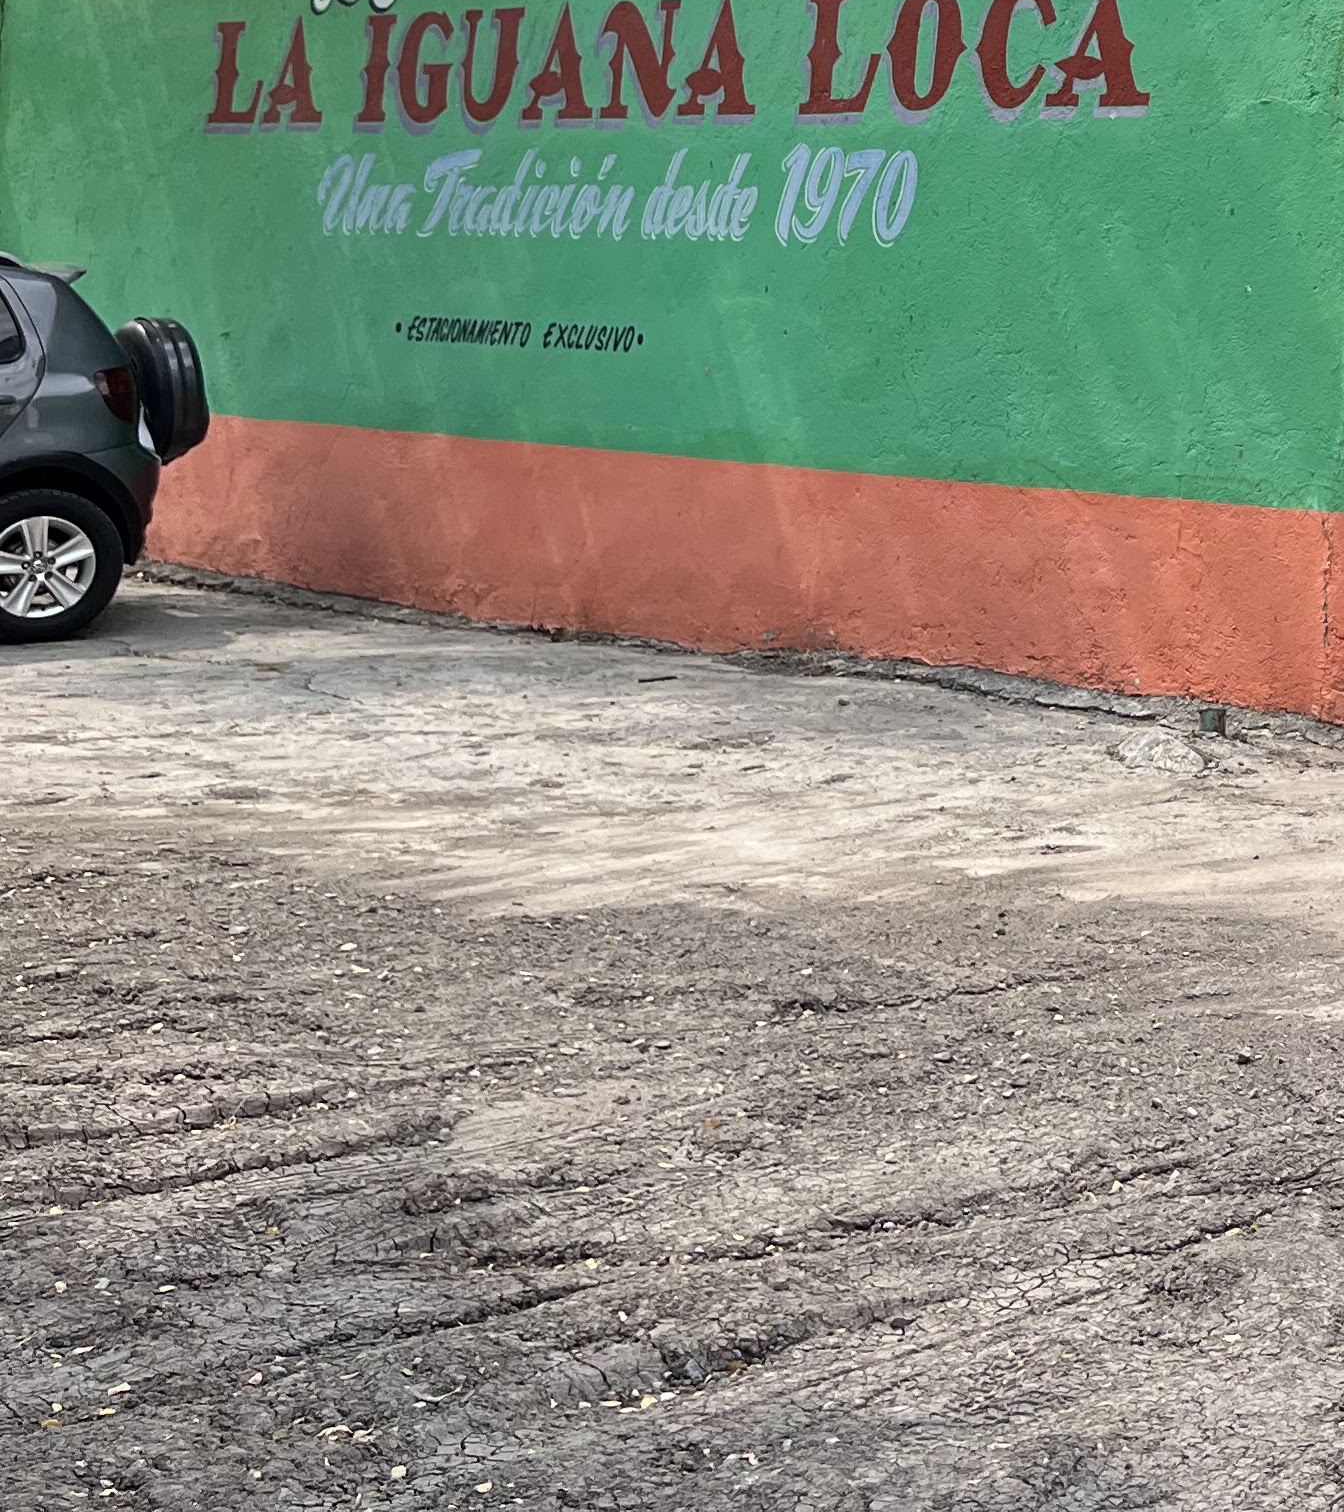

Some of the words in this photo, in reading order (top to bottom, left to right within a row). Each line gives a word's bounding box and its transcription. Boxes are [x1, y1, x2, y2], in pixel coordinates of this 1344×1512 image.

[204, 14, 323, 134] LA
[317, 151, 416, 238] Una
[416, 147, 635, 240] Tradición
[641, 147, 758, 242] desde
[774, 143, 919, 247] 1970
[406, 315, 532, 349] ESTACIONAMIENTO
[542, 321, 637, 353] EXCLUSIVO
